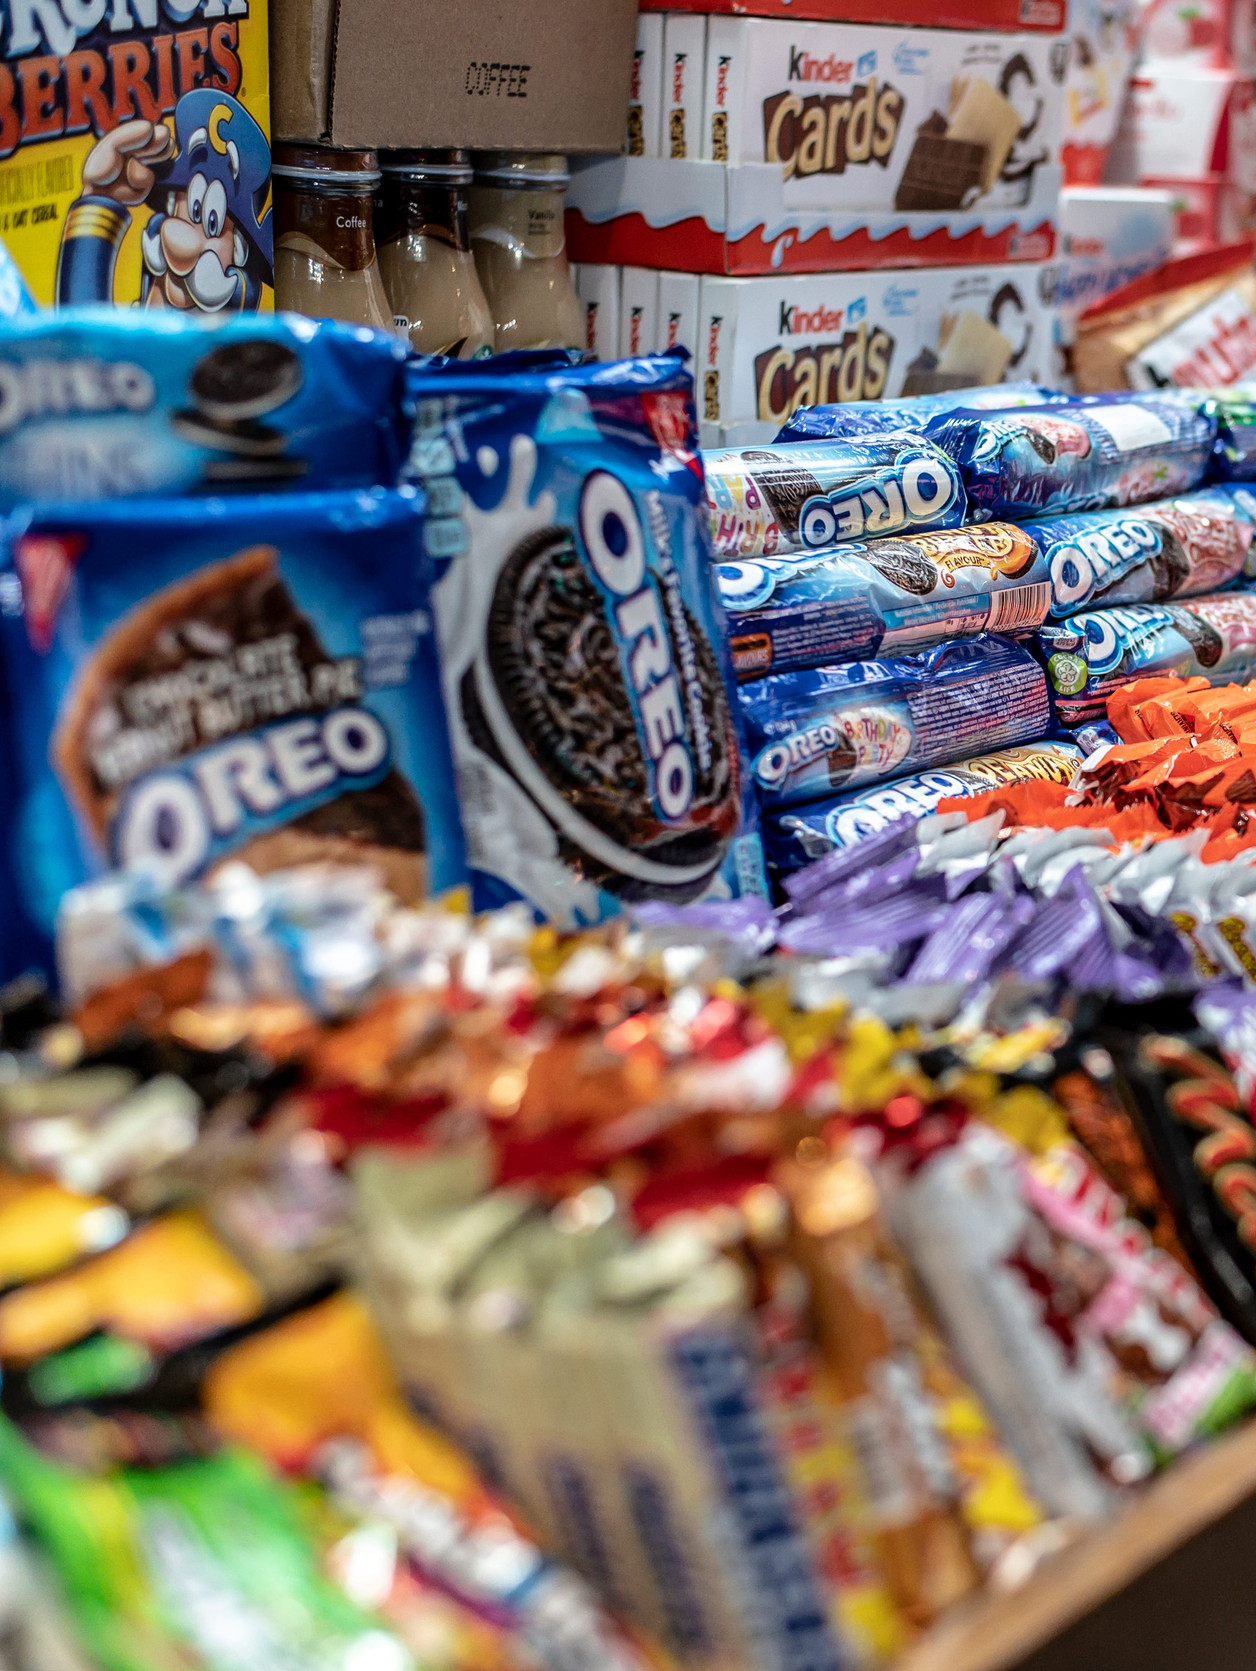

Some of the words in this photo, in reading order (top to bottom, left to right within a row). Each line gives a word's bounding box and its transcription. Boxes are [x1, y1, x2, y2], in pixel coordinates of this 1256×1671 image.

[465, 62, 531, 98] COFFEE
[767, 76, 900, 181] Cards
[336, 216, 367, 228] Coffee
[759, 321, 889, 426] Cards
[805, 457, 953, 544] OREO
[1050, 520, 1156, 605] OREO
[578, 469, 695, 821] OREO
[1059, 684, 1077, 693] LIFE
[117, 707, 390, 882] OREO
[757, 725, 836, 783] OREO
